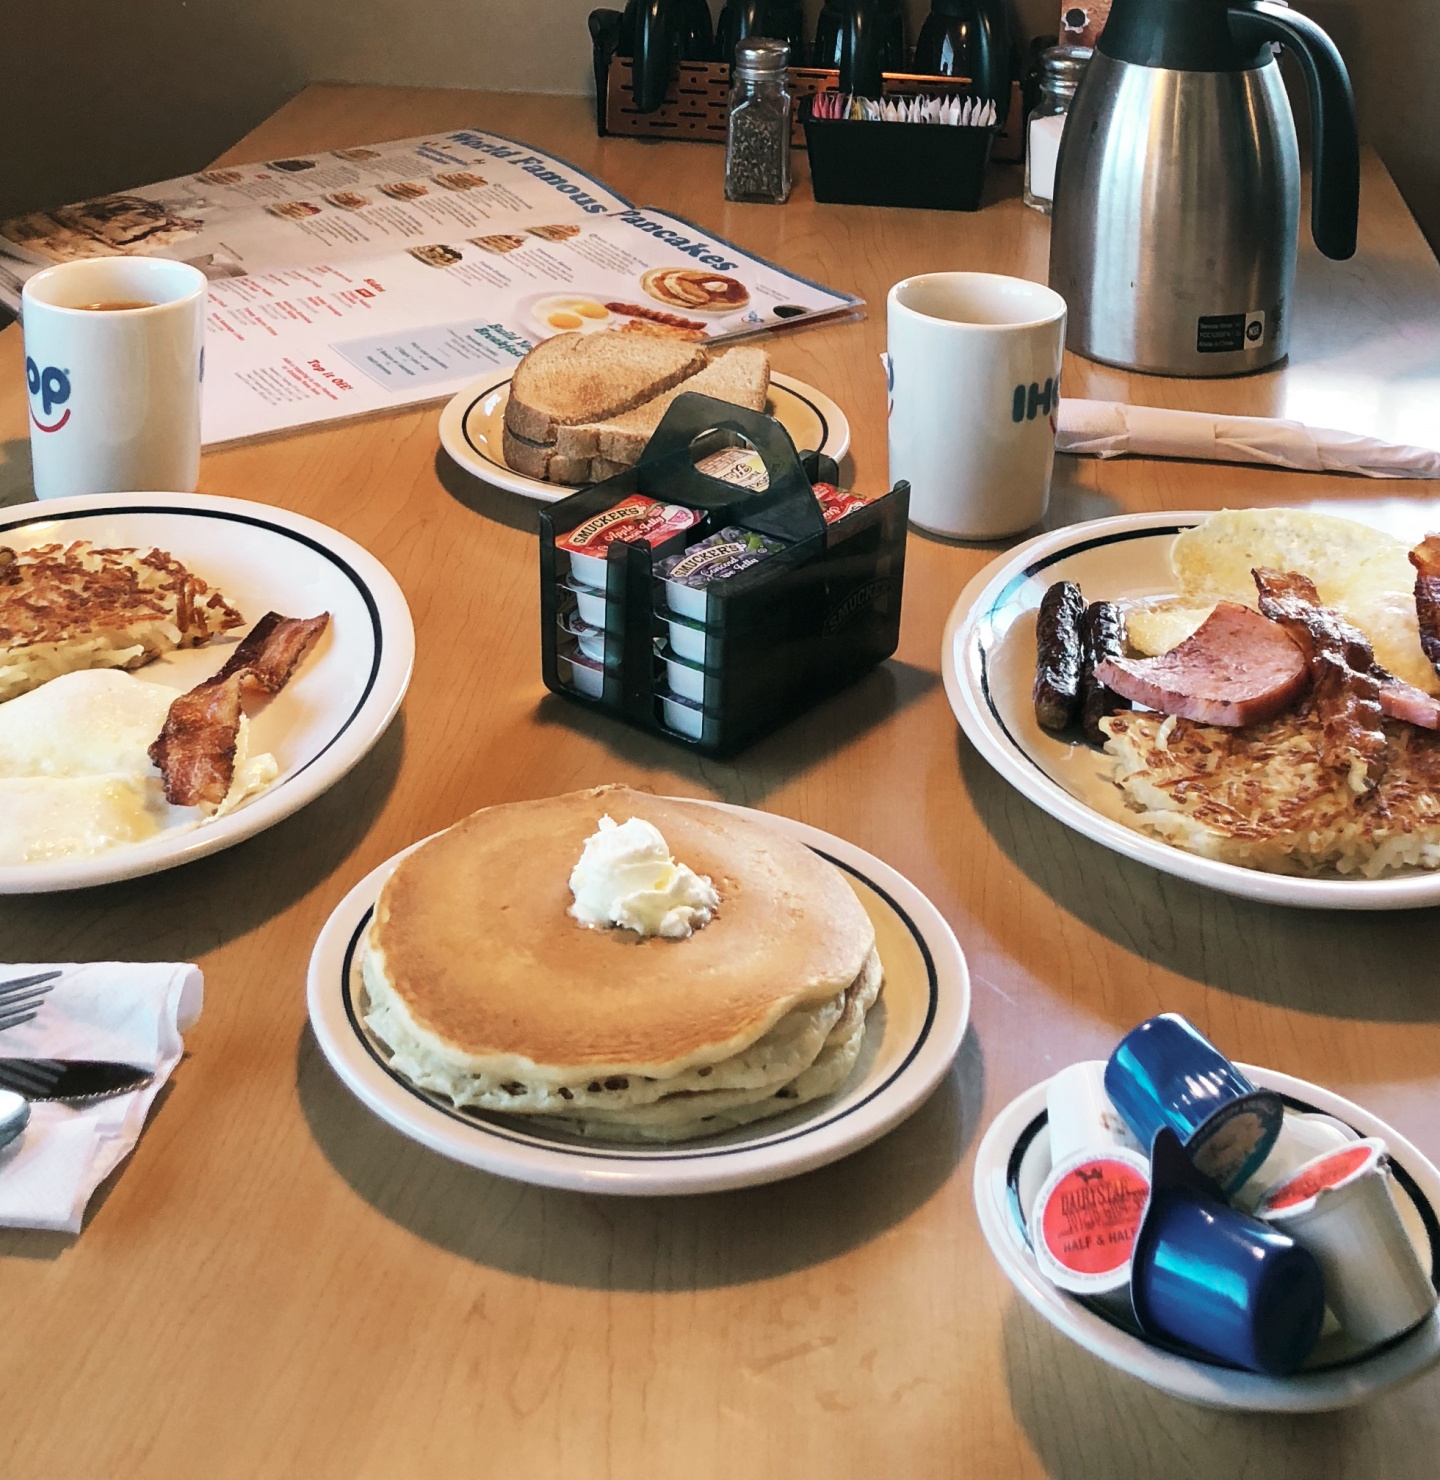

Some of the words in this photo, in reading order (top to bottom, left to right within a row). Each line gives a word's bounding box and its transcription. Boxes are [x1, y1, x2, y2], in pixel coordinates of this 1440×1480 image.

[446, 132, 523, 159] World
[507, 156, 609, 214] Famous
[608, 209, 739, 271] Pancakes
[487, 323, 522, 341] Build
[307, 358, 326, 373] Top
[573, 507, 640, 545] SMUCKER'S
[604, 524, 635, 542] Apple
[639, 516, 666, 532] Jelly
[674, 544, 738, 576] SMUCKER'S
[700, 556, 739, 578] Concord
[734, 558, 759, 571] Jelly
[1063, 1235, 1092, 1253] HALF
[1096, 1234, 1105, 1246] &
